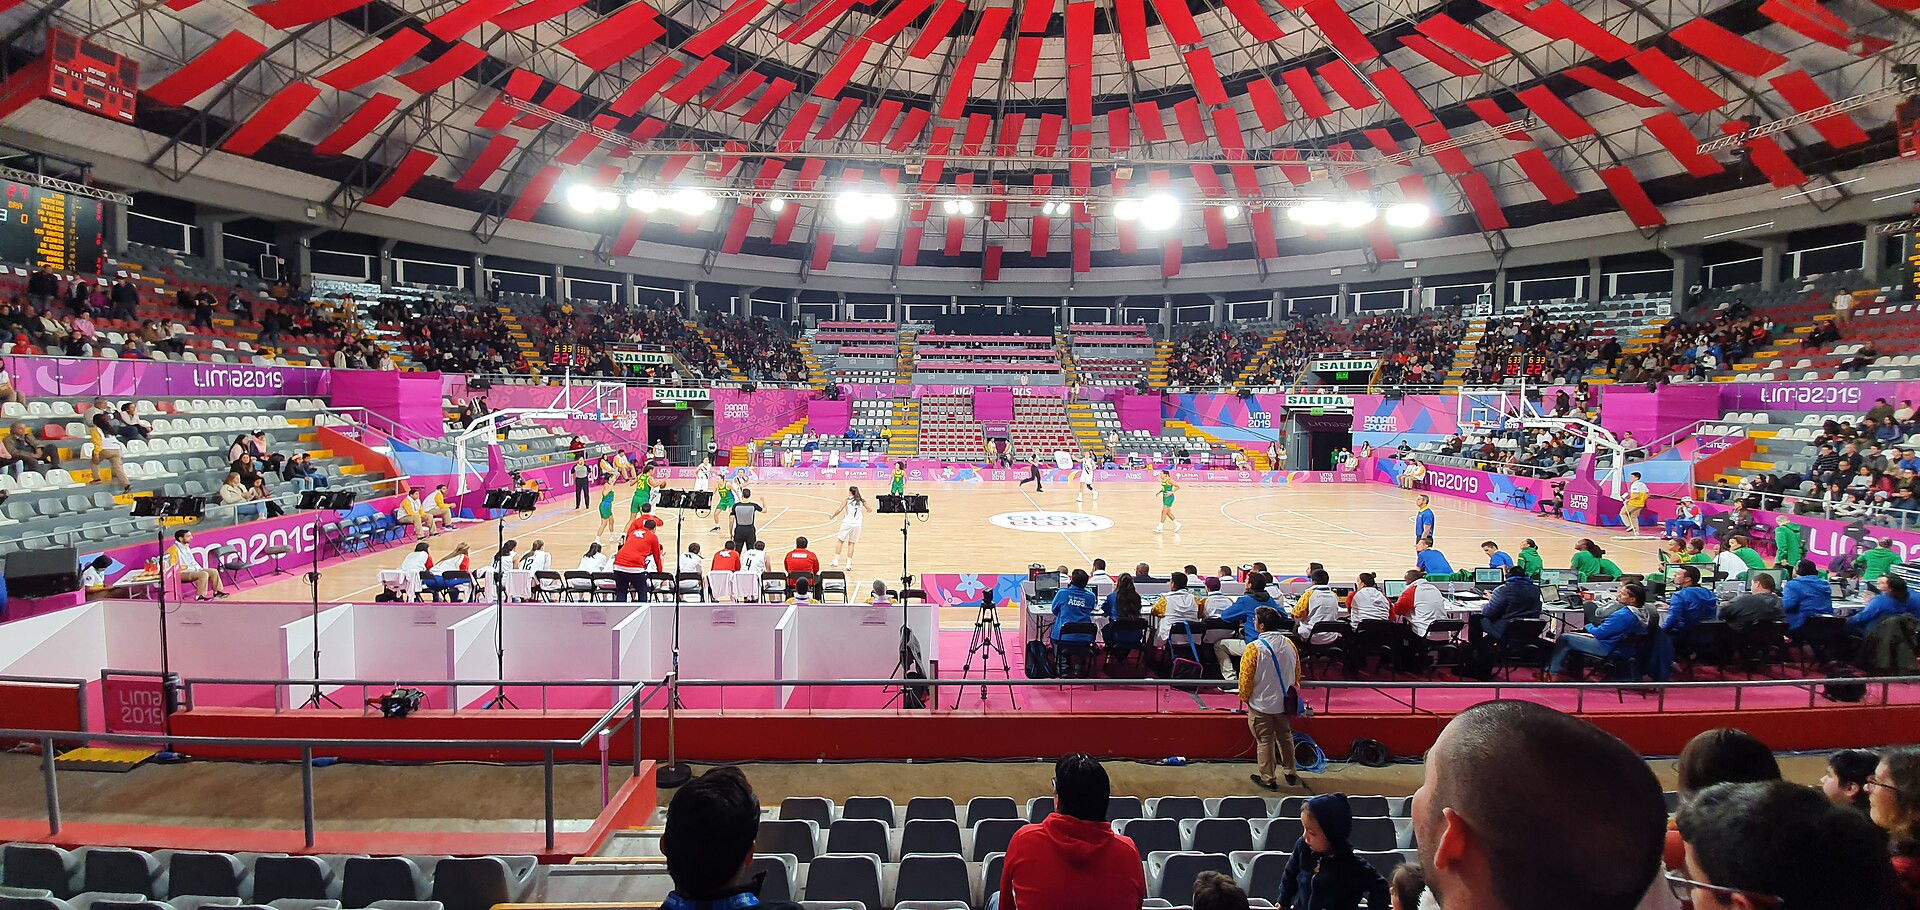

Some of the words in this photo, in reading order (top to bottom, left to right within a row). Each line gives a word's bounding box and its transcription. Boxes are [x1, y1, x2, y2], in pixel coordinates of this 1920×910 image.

[552, 353, 569, 364] 22
[614, 353, 664, 363] SALIDA
[1319, 361, 1374, 371] SALIDA
[1506, 364, 1519, 375] 22
[1526, 364, 1543, 375] 22
[655, 389, 707, 399] SALIDA
[1287, 396, 1345, 405] SALIDA
[724, 411, 750, 419] SPORTS
[1248, 419, 1272, 428] 2019
[1363, 423, 1398, 432] SPORTS
[1570, 500, 1588, 510] 2019
[521, 558, 534, 571] 12
[745, 558, 753, 571] 4
[121, 706, 164, 724] 2019
